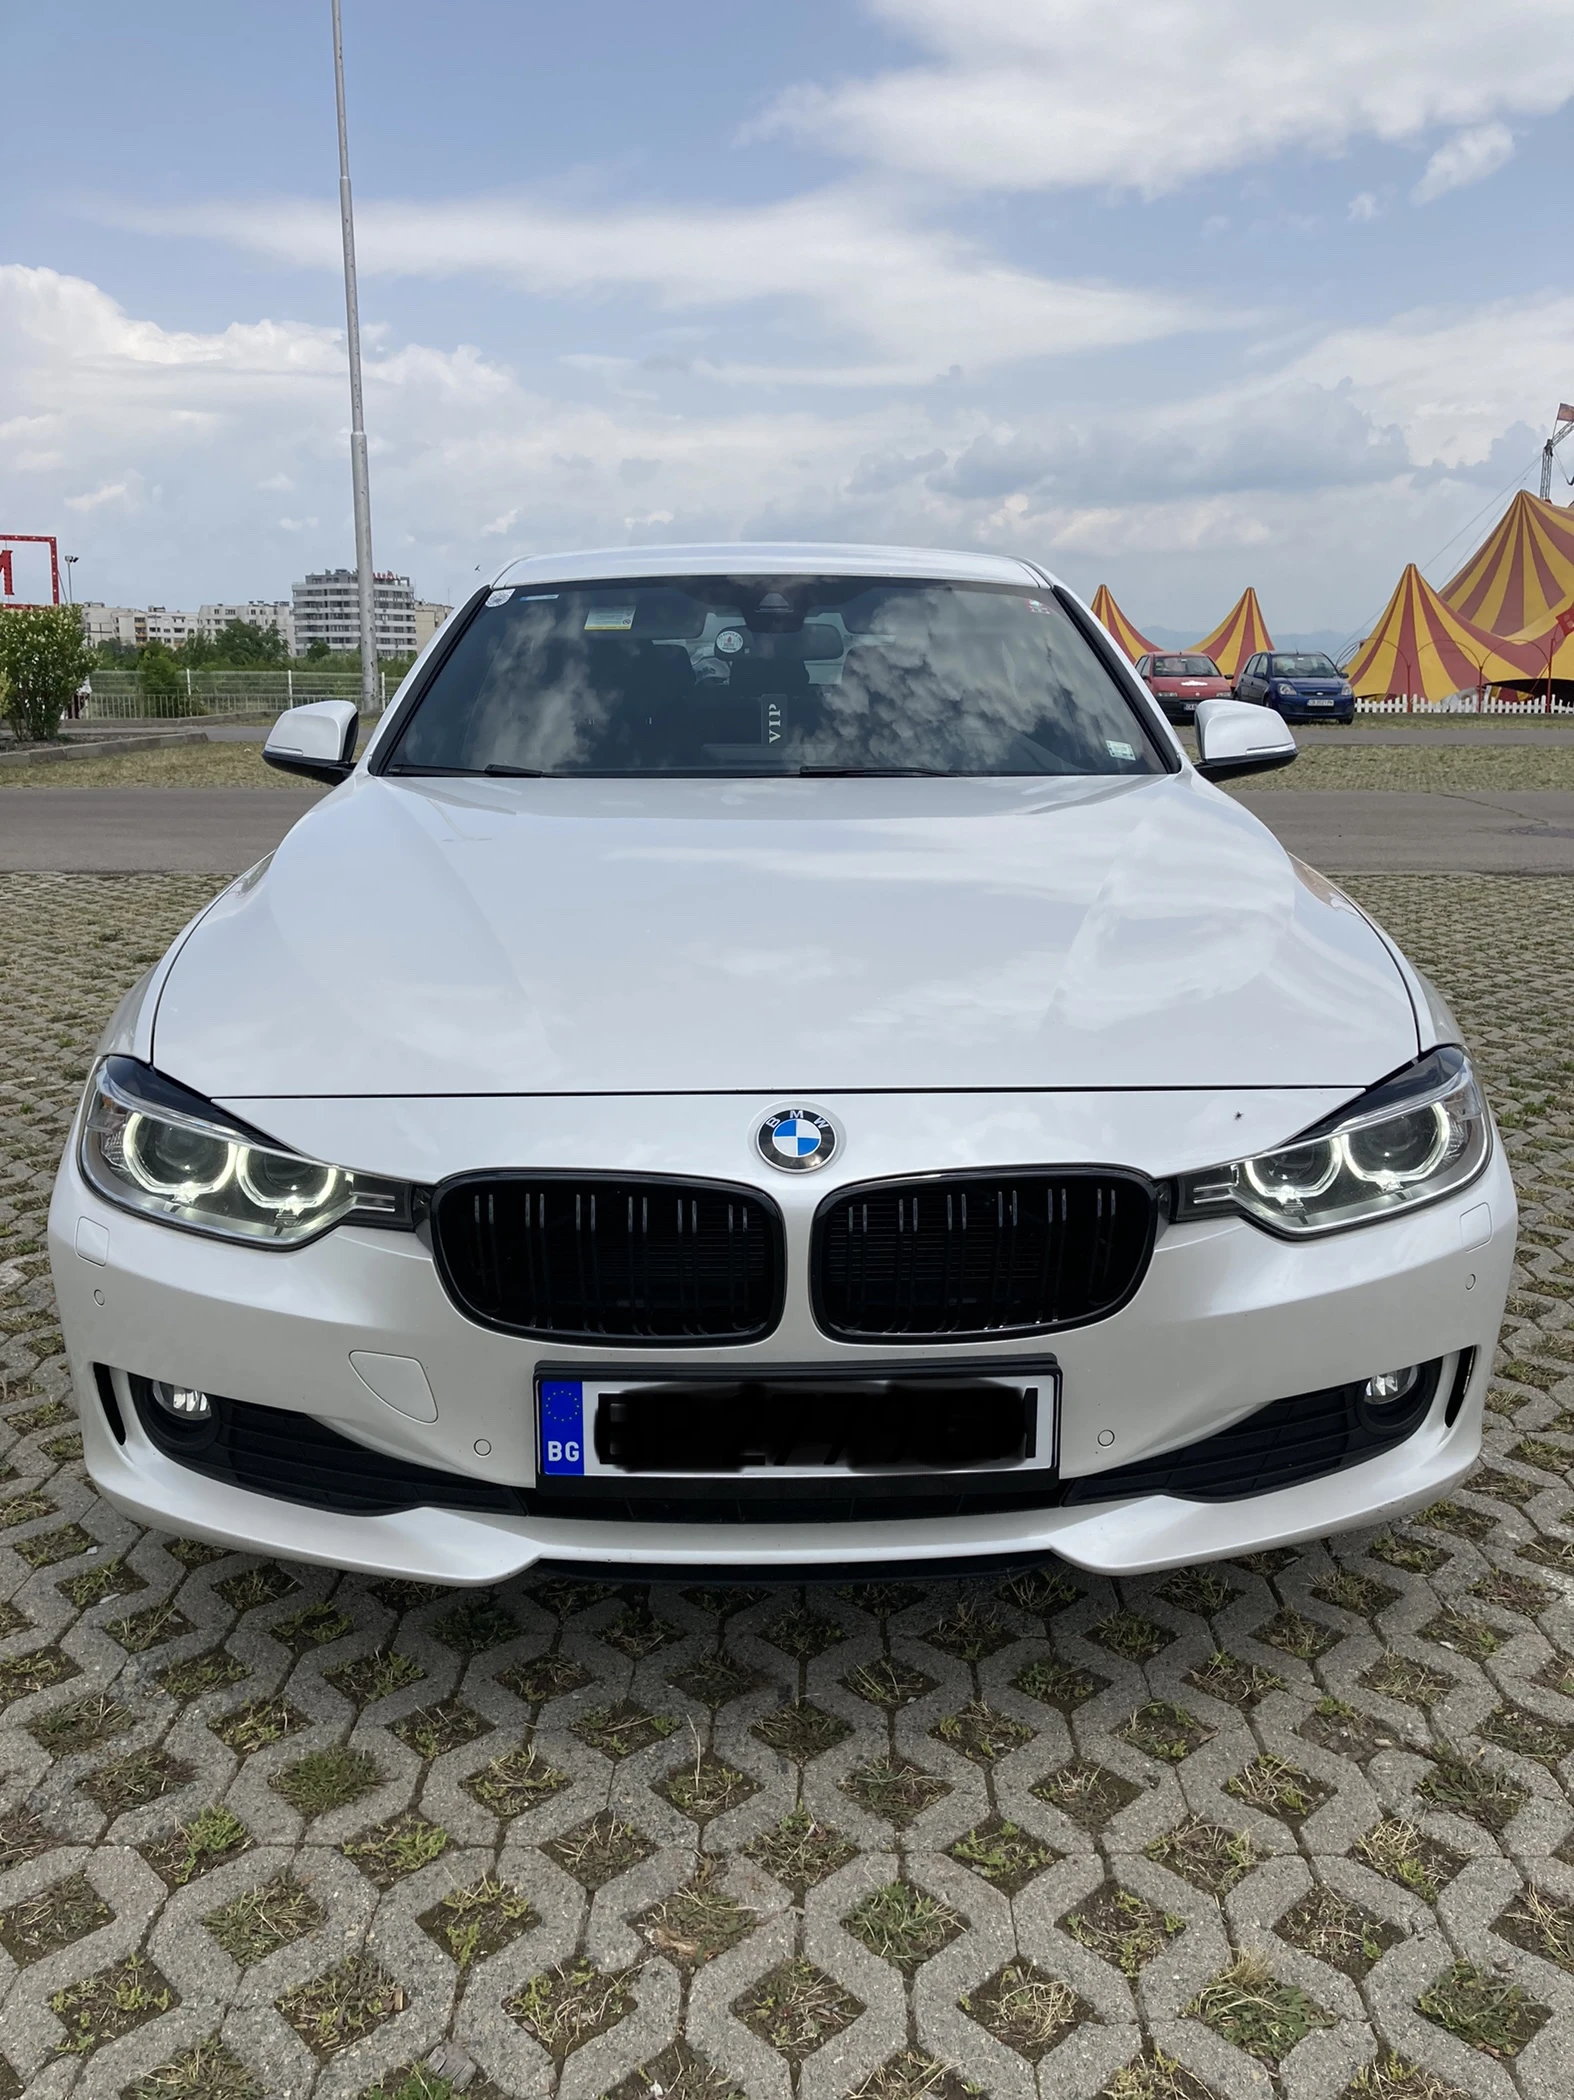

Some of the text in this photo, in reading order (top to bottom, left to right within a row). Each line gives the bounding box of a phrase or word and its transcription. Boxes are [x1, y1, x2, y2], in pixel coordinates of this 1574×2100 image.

[768, 703, 781, 744] VIP
[765, 1109, 830, 1129] BMW
[548, 1440, 580, 1462] BG
